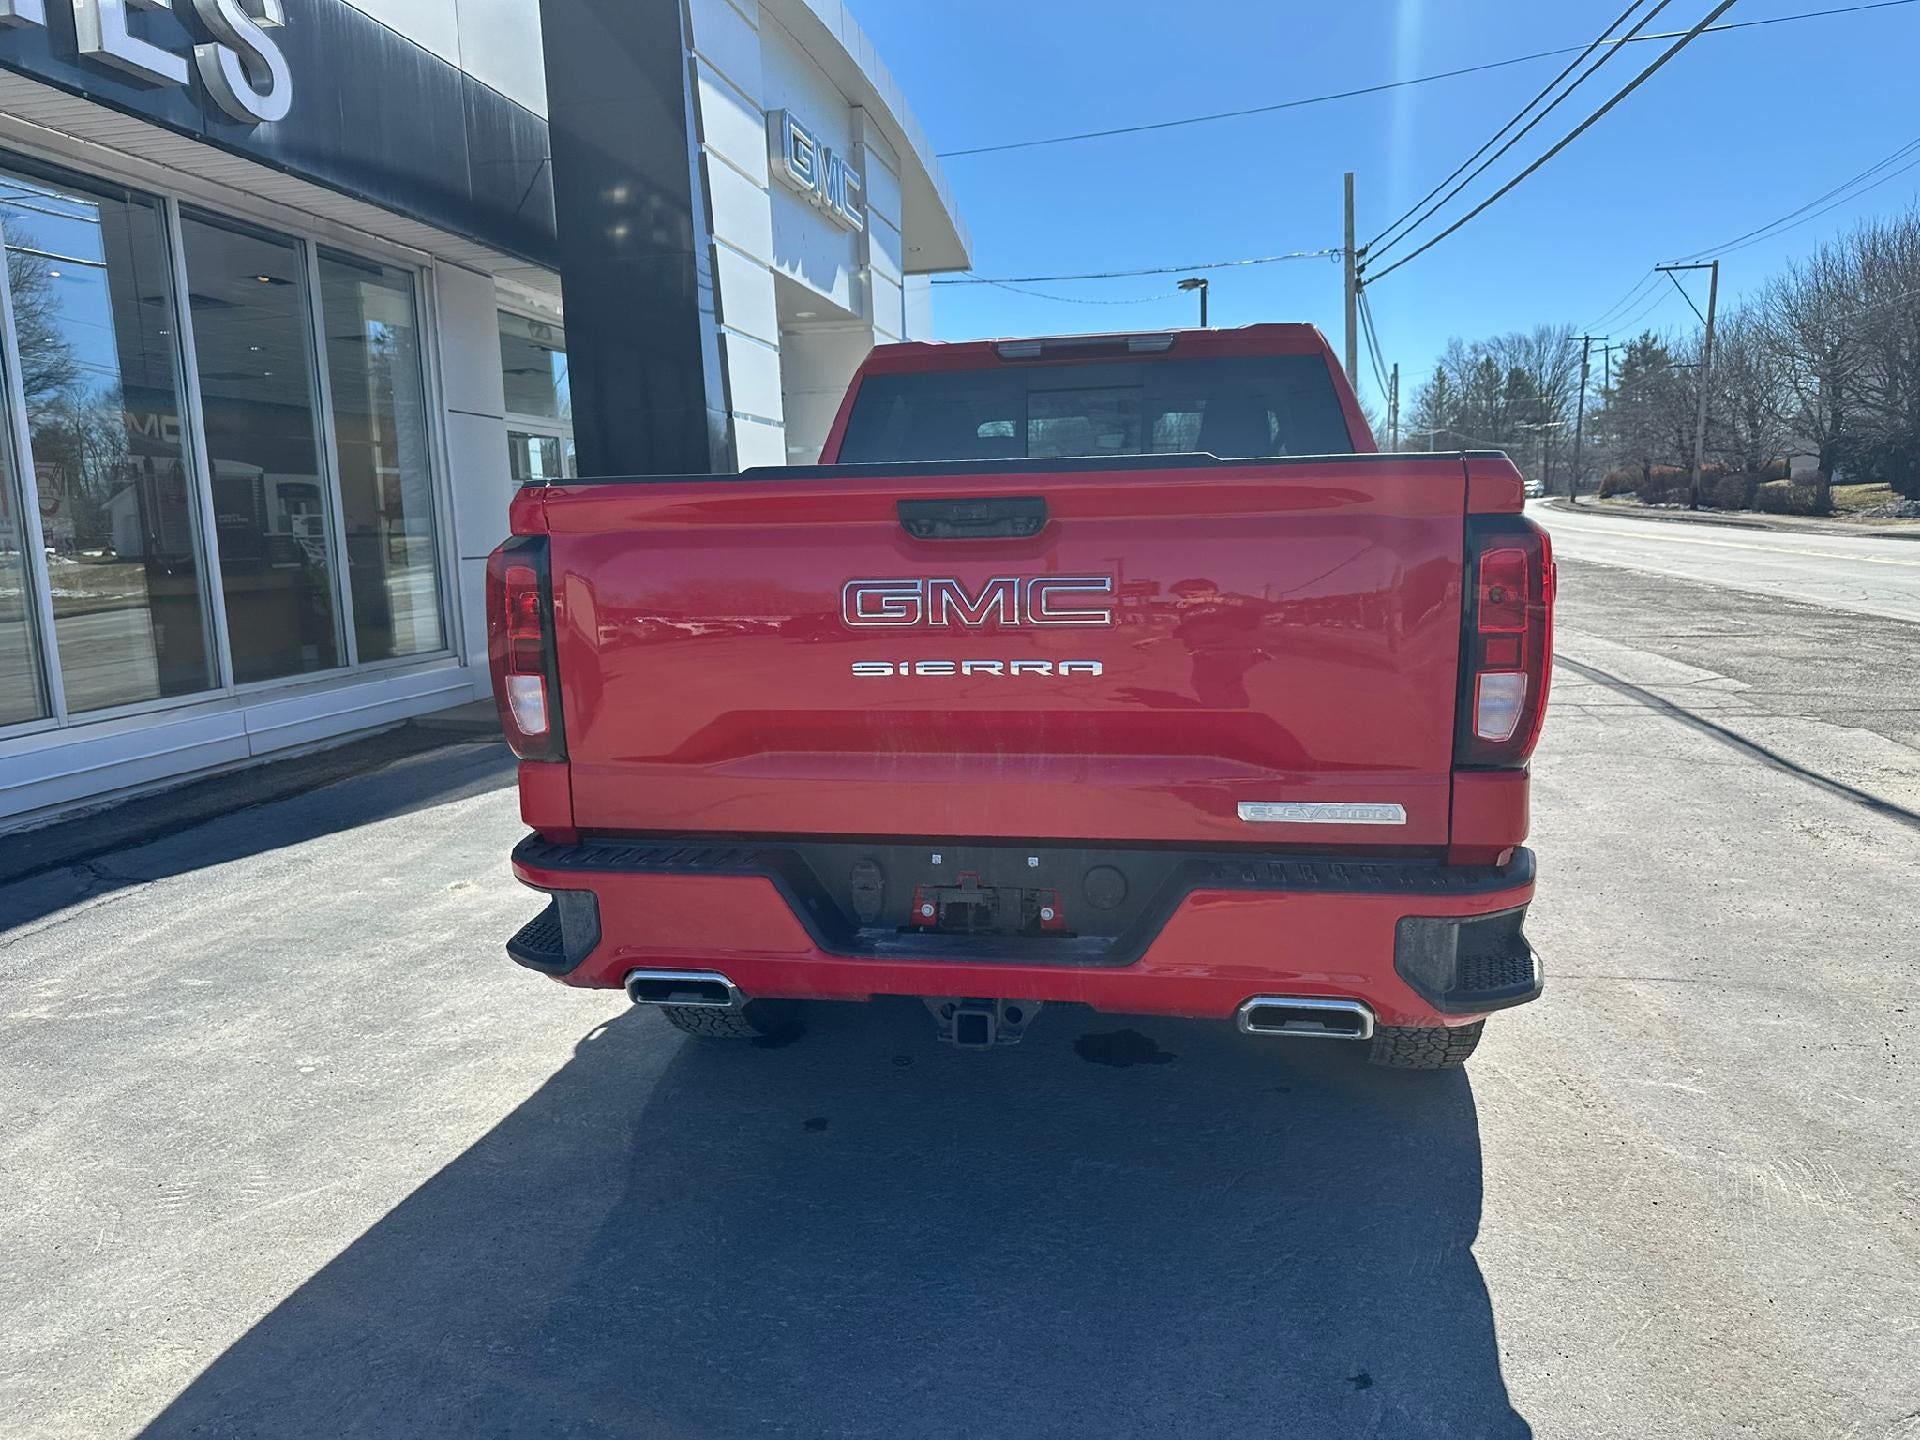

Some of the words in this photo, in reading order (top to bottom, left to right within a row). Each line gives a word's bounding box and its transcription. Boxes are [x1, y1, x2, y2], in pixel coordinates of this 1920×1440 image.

[783, 108, 863, 232] GMC
[843, 577, 1111, 626] GMC
[852, 660, 1104, 676] SIERRA
[1249, 805, 1396, 820] ELEVATION
